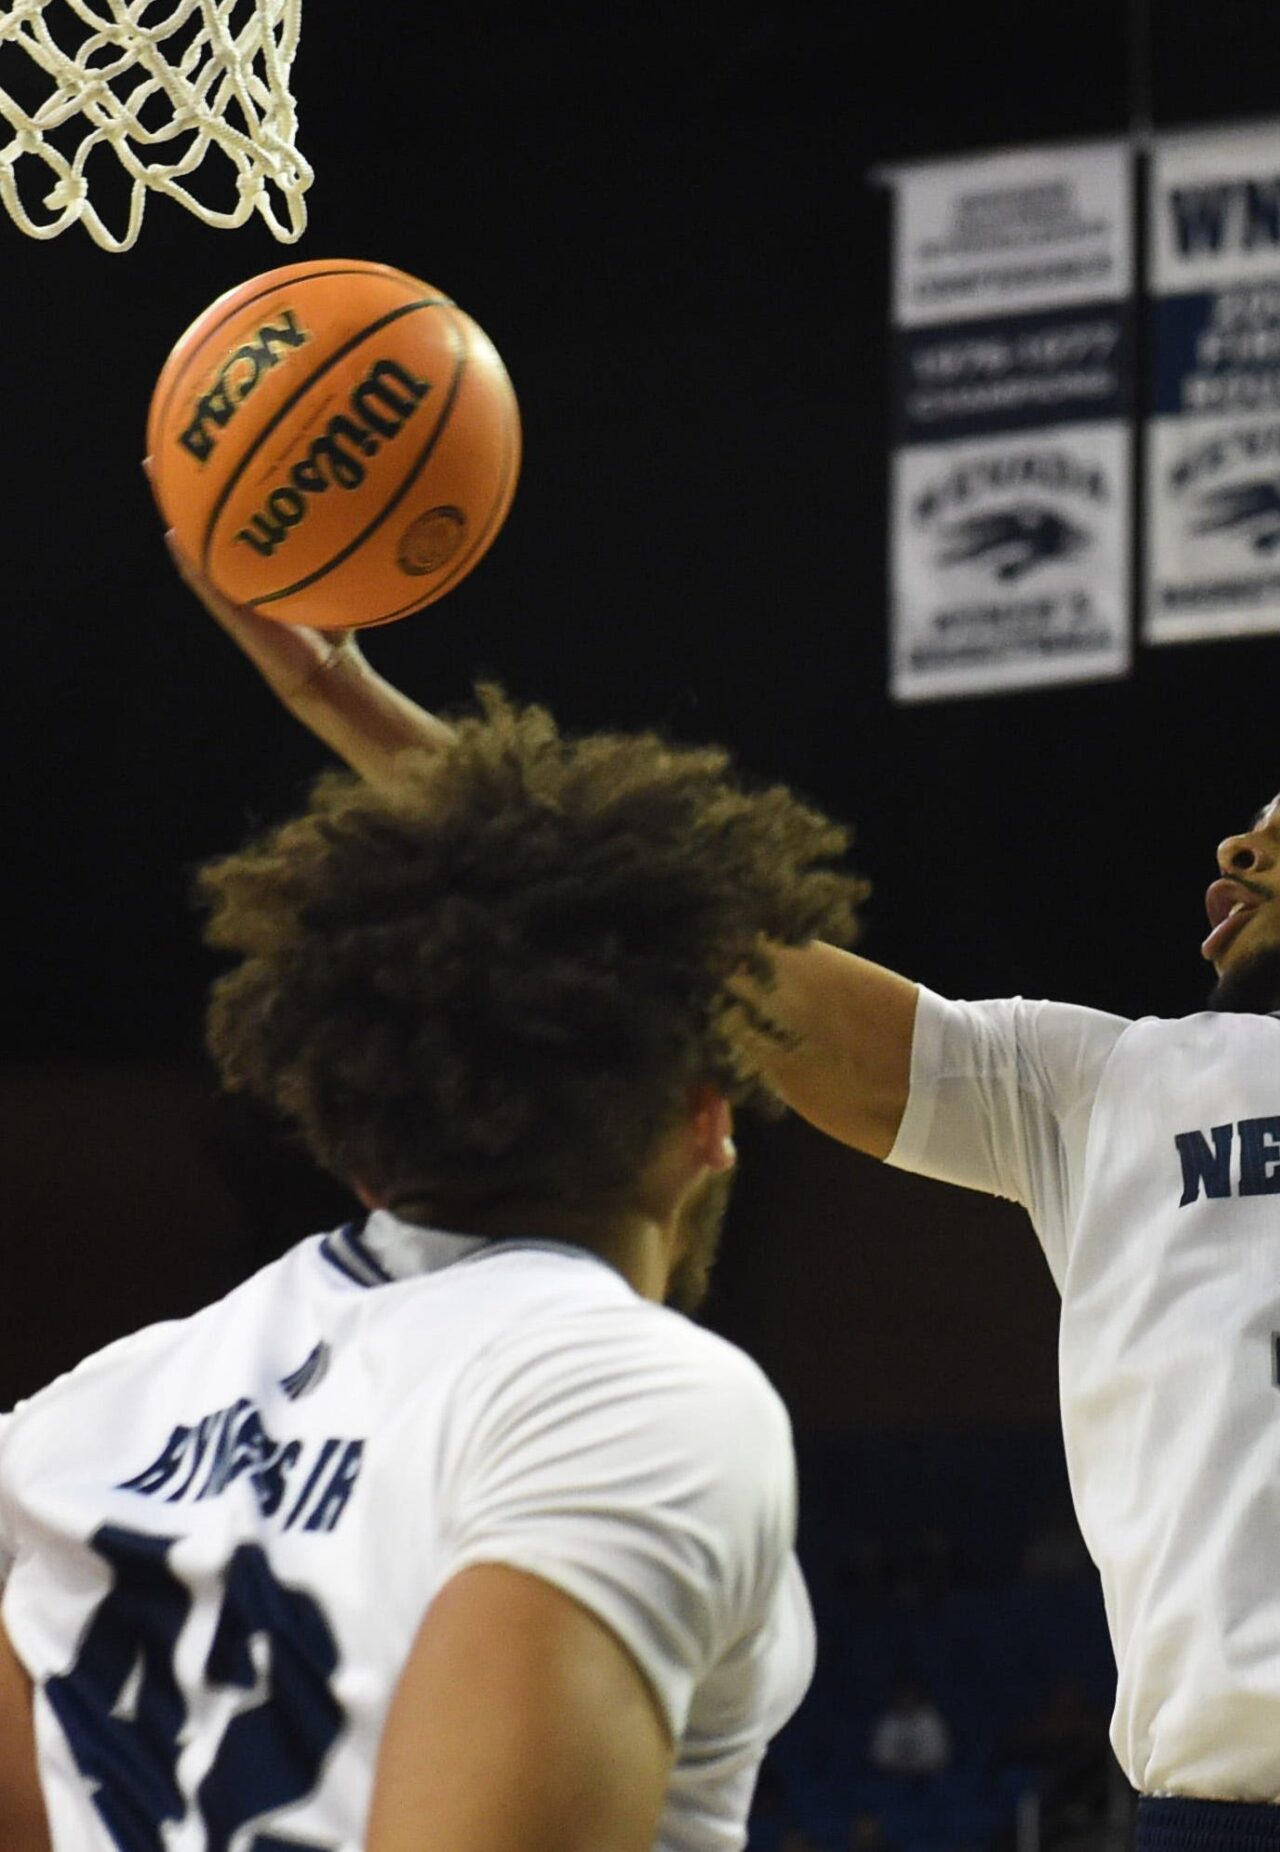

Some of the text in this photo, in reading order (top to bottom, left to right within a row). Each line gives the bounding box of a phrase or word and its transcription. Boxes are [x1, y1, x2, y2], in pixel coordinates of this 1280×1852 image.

[177, 309, 309, 466] NCAA
[235, 358, 431, 557] Wilson
[912, 448, 1110, 524] NEVADA
[44, 1524, 348, 1852] 42
